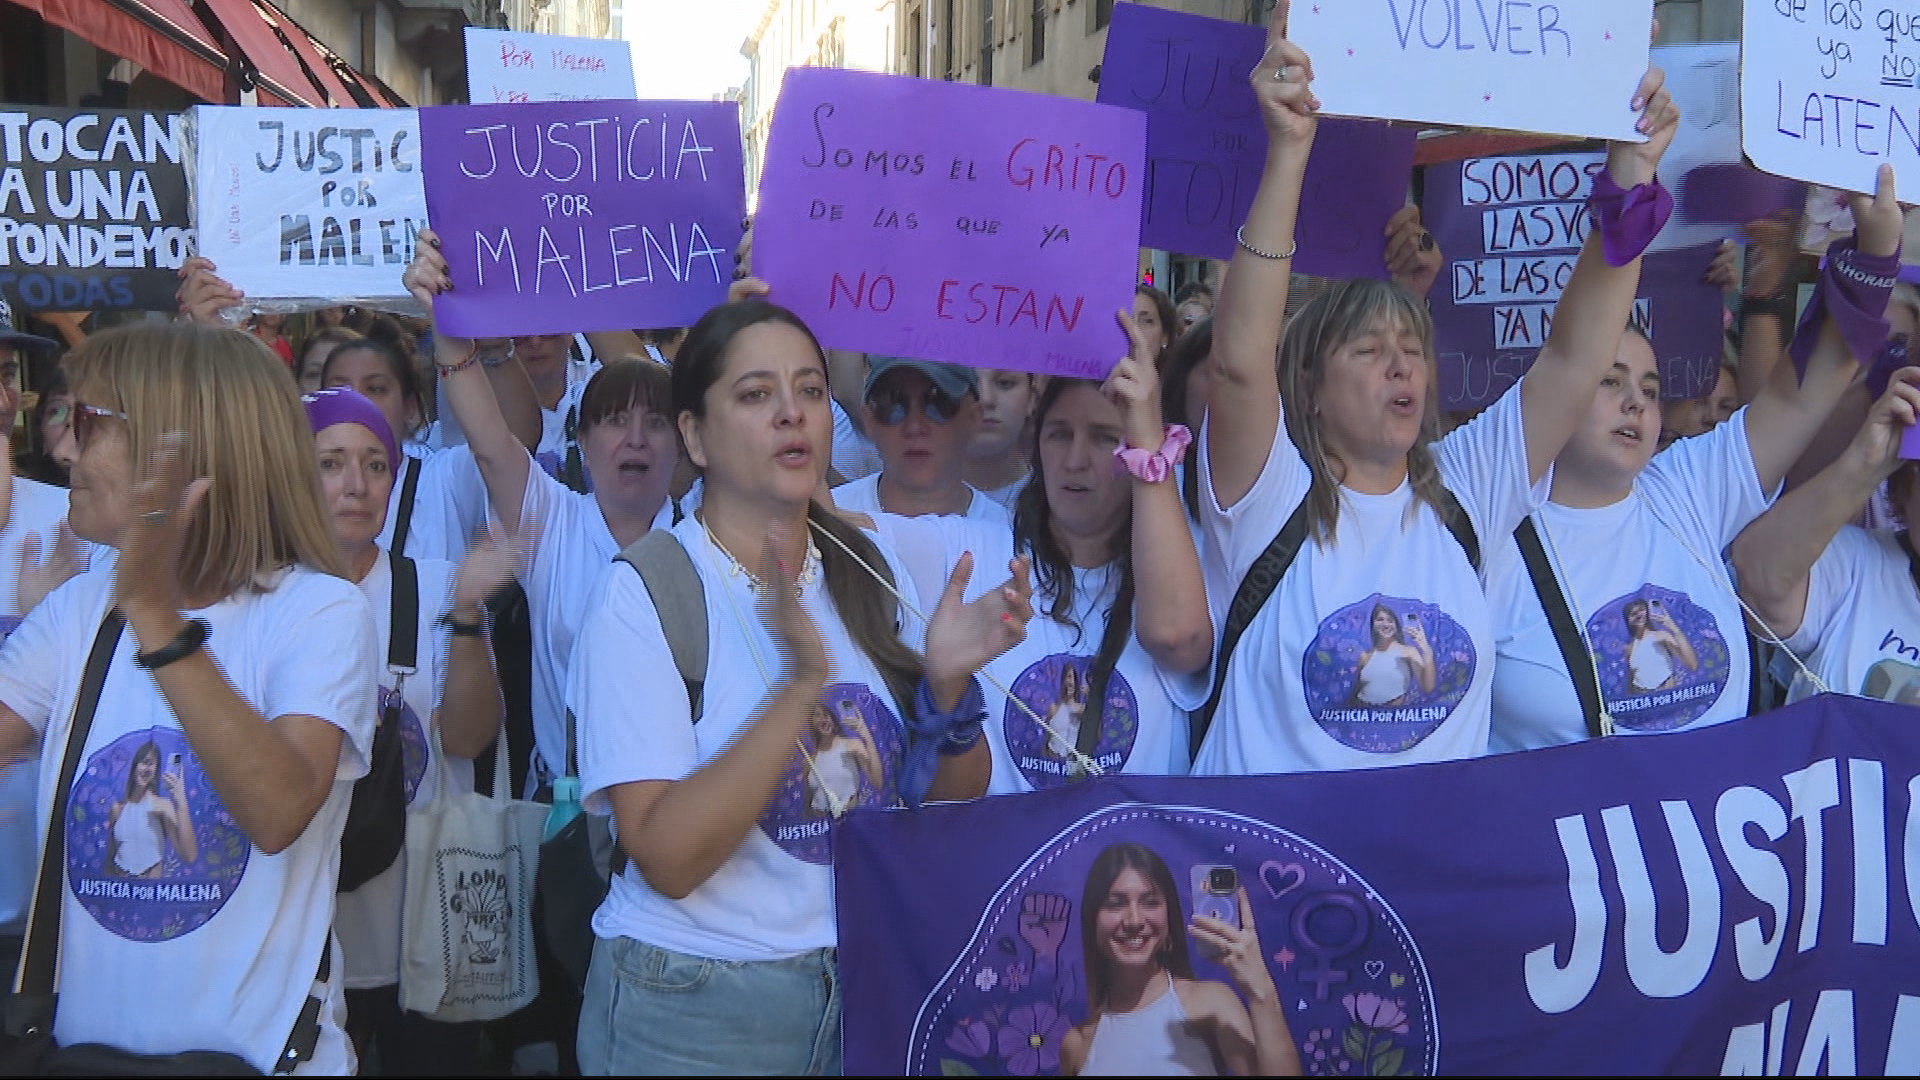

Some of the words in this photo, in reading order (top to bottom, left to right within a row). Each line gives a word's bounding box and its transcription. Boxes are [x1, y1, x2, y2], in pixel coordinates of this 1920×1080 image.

[1817, 36, 1852, 79] ya
[1882, 54, 1916, 78] NO
[949, 160, 978, 182] EL
[0, 168, 36, 214] A
[45, 168, 162, 221] UNA
[541, 192, 593, 218] POR
[808, 199, 844, 222] DE
[872, 207, 920, 231] LAS
[956, 216, 1000, 237] QUE
[1040, 224, 1071, 249] YA
[1490, 206, 1554, 250] LAS
[474, 222, 726, 298] MALENA
[1454, 260, 1487, 300] DE
[1500, 256, 1550, 295] LAS
[936, 278, 1085, 334] ESTAN
[1496, 308, 1530, 345] YA
[1672, 682, 1716, 703] MALENA
[1319, 709, 1370, 722] JUSTICIA
[1394, 706, 1447, 722] MALENA
[78, 878, 130, 899] JUSTICIA
[156, 883, 222, 902] MALENA
